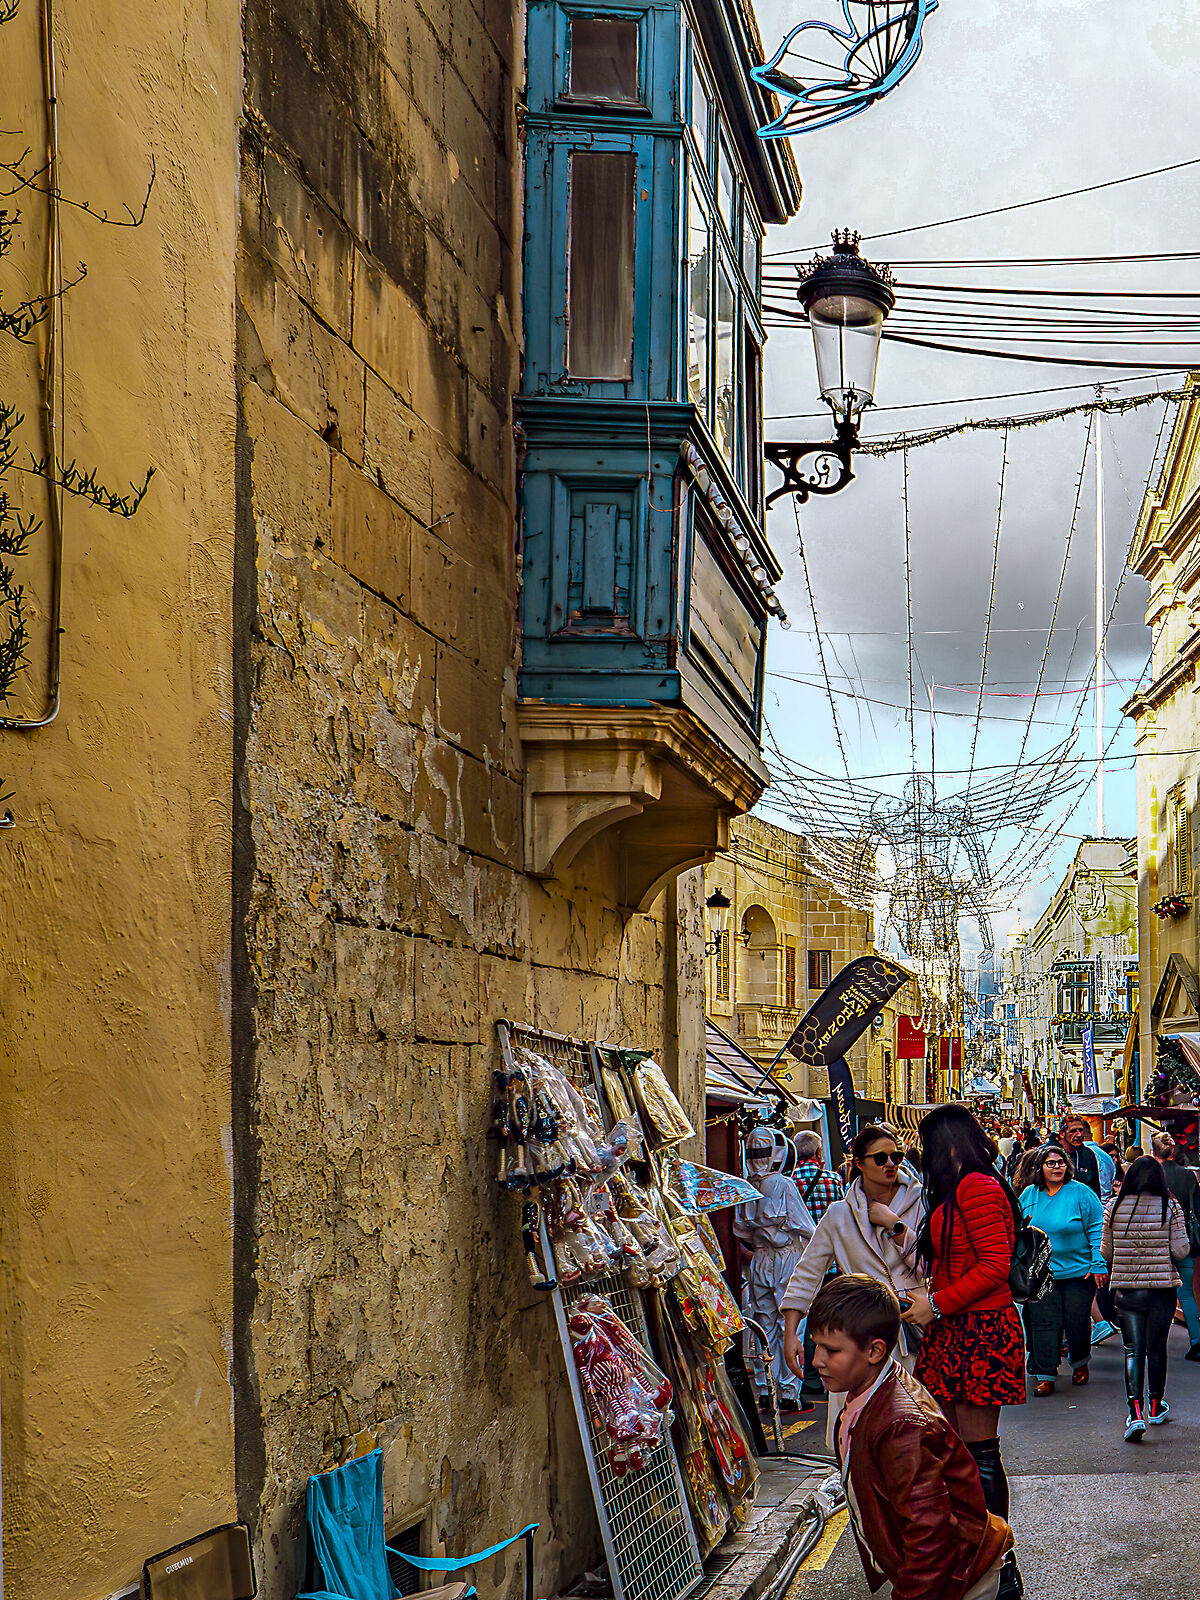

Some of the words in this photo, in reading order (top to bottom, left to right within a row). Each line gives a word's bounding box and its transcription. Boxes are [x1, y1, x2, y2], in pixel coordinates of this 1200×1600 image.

[839, 992, 866, 1018] RAW
[818, 1006, 854, 1050] HONEY
[165, 1556, 194, 1575] QUECHUA
